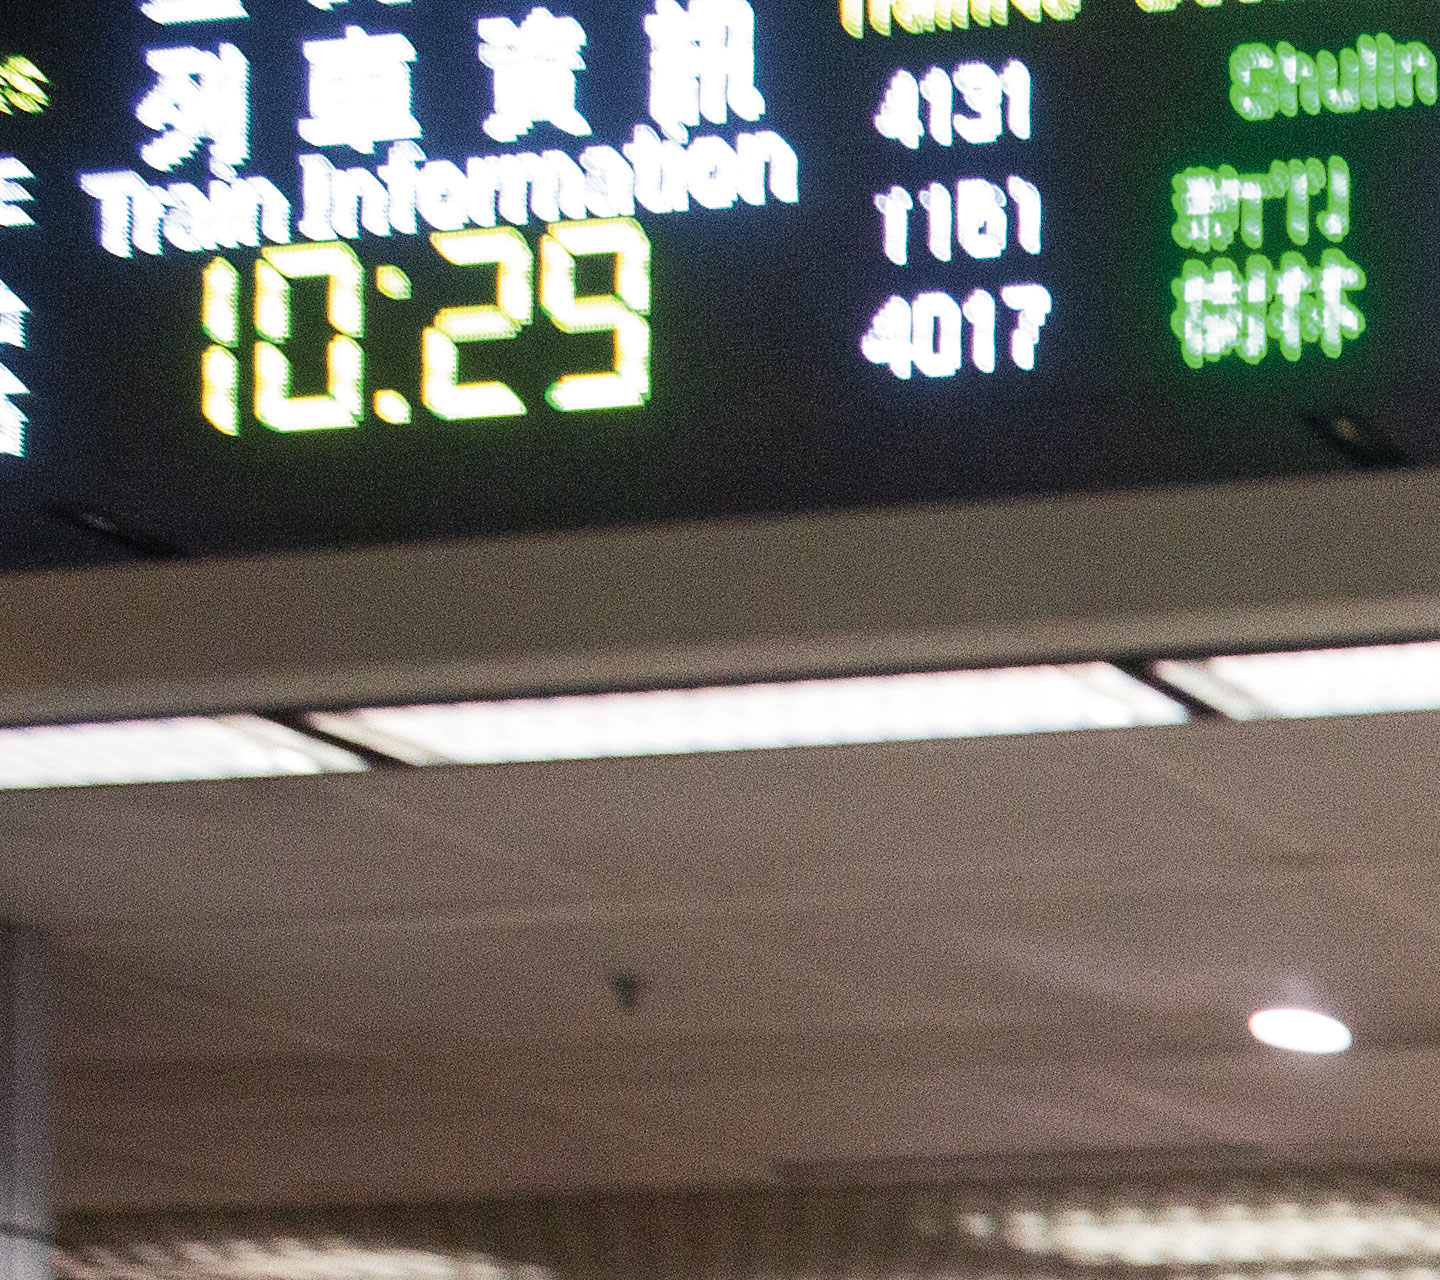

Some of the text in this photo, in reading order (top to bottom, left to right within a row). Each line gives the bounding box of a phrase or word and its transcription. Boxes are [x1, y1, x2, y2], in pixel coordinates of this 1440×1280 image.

[873, 58, 1032, 149] 4131
[1229, 32, 1437, 120] Shulin
[77, 165, 290, 258] Train
[298, 122, 800, 240] Information
[200, 216, 651, 436] 10:29
[859, 282, 1052, 379] 4017
